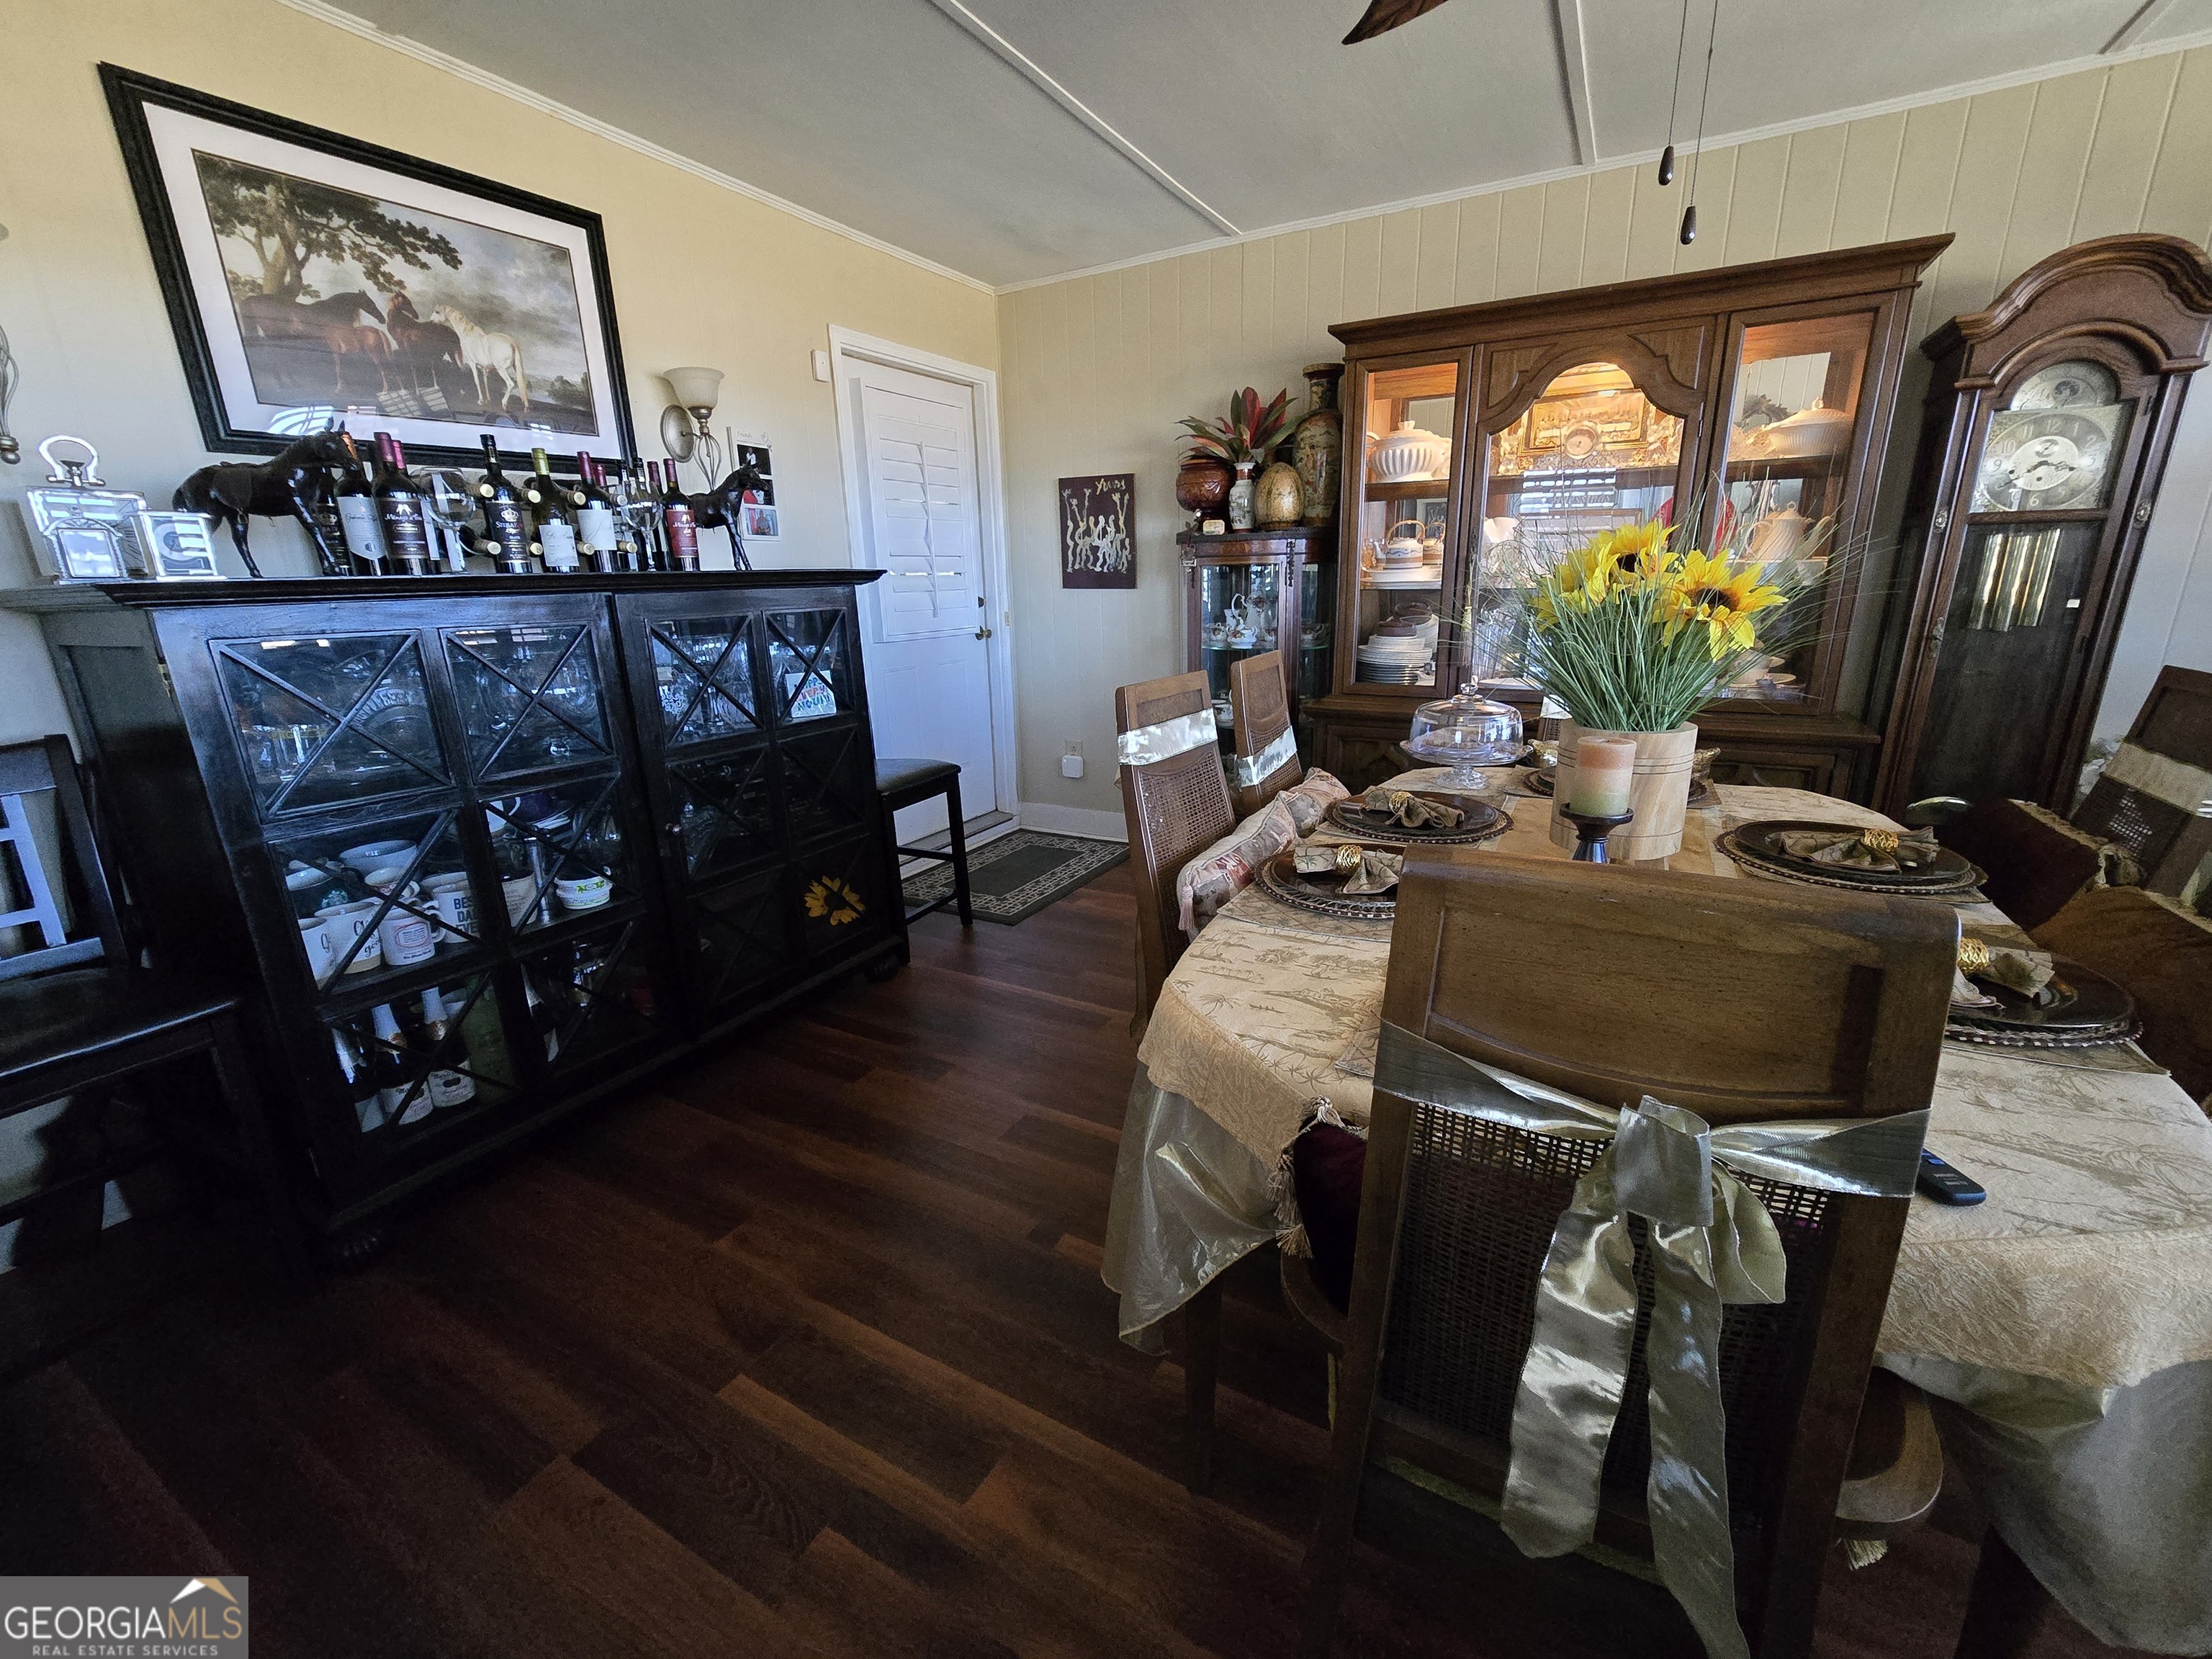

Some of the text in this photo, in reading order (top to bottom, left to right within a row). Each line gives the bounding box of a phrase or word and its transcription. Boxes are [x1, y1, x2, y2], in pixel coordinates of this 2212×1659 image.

[2023, 425, 2034, 437] 11
[2046, 419, 2062, 433] 12
[2000, 440, 2015, 454] 10
[1993, 459, 2002, 472] 9
[2029, 493, 2040, 507] 6
